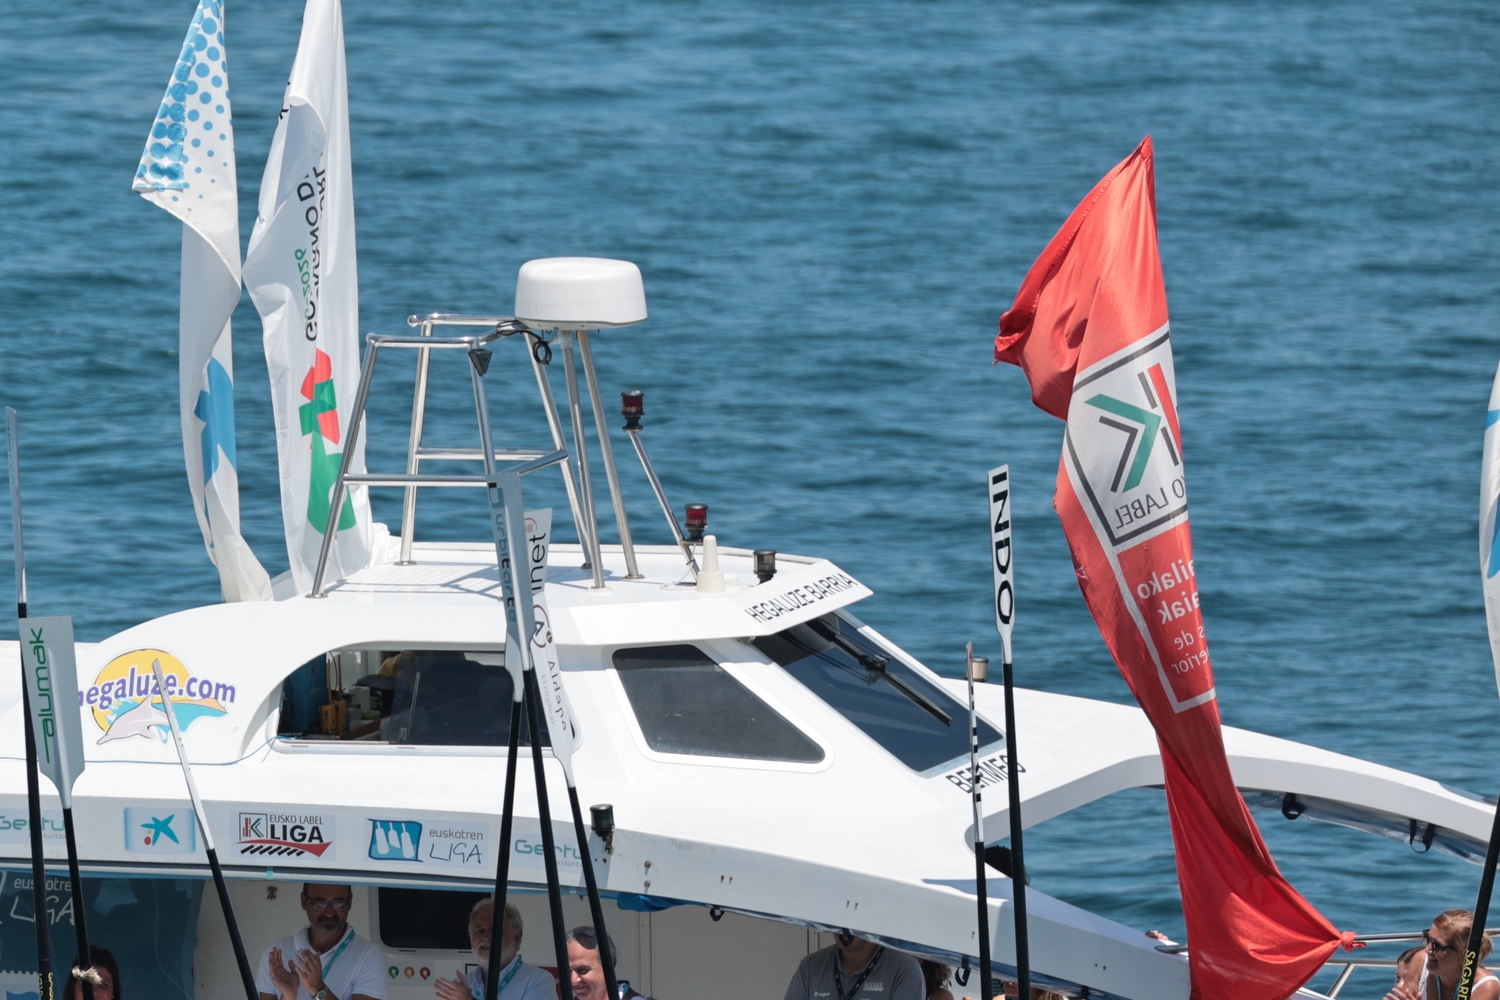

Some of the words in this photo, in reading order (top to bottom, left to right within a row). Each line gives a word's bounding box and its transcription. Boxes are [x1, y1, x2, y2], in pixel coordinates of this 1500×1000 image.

[992, 472, 1015, 626] INDO
[745, 588, 812, 624] HEGALUZE
[806, 571, 860, 601] BARRIA
[29, 627, 56, 745] alumak
[269, 814, 297, 824] EUSKO
[299, 815, 324, 825] LABEL
[269, 824, 324, 843] LIGA
[429, 828, 484, 840] euskotren
[429, 842, 483, 864] LIGA
